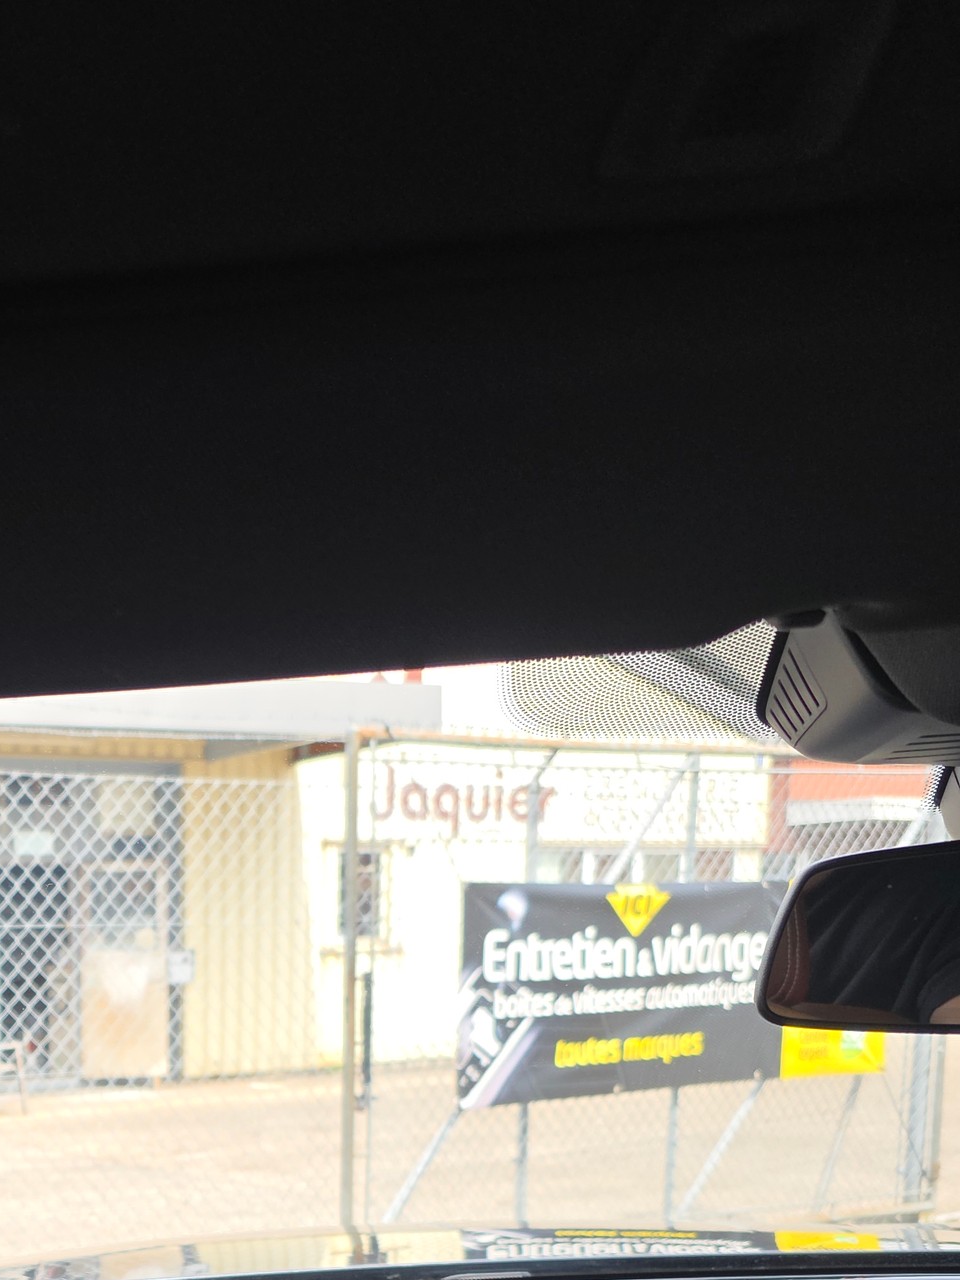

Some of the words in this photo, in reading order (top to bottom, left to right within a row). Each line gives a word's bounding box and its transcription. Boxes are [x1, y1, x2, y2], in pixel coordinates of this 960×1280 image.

[371, 764, 558, 838] Jaquier
[622, 894, 653, 916] ICI
[483, 925, 638, 983] Entretien
[637, 947, 654, 978] &
[492, 986, 556, 1019] boîtes
[555, 994, 573, 1015] de
[572, 984, 645, 1014] vitesses
[645, 977, 755, 1011] automatiques
[554, 1037, 622, 1068] toutes
[622, 1031, 705, 1065] marques
